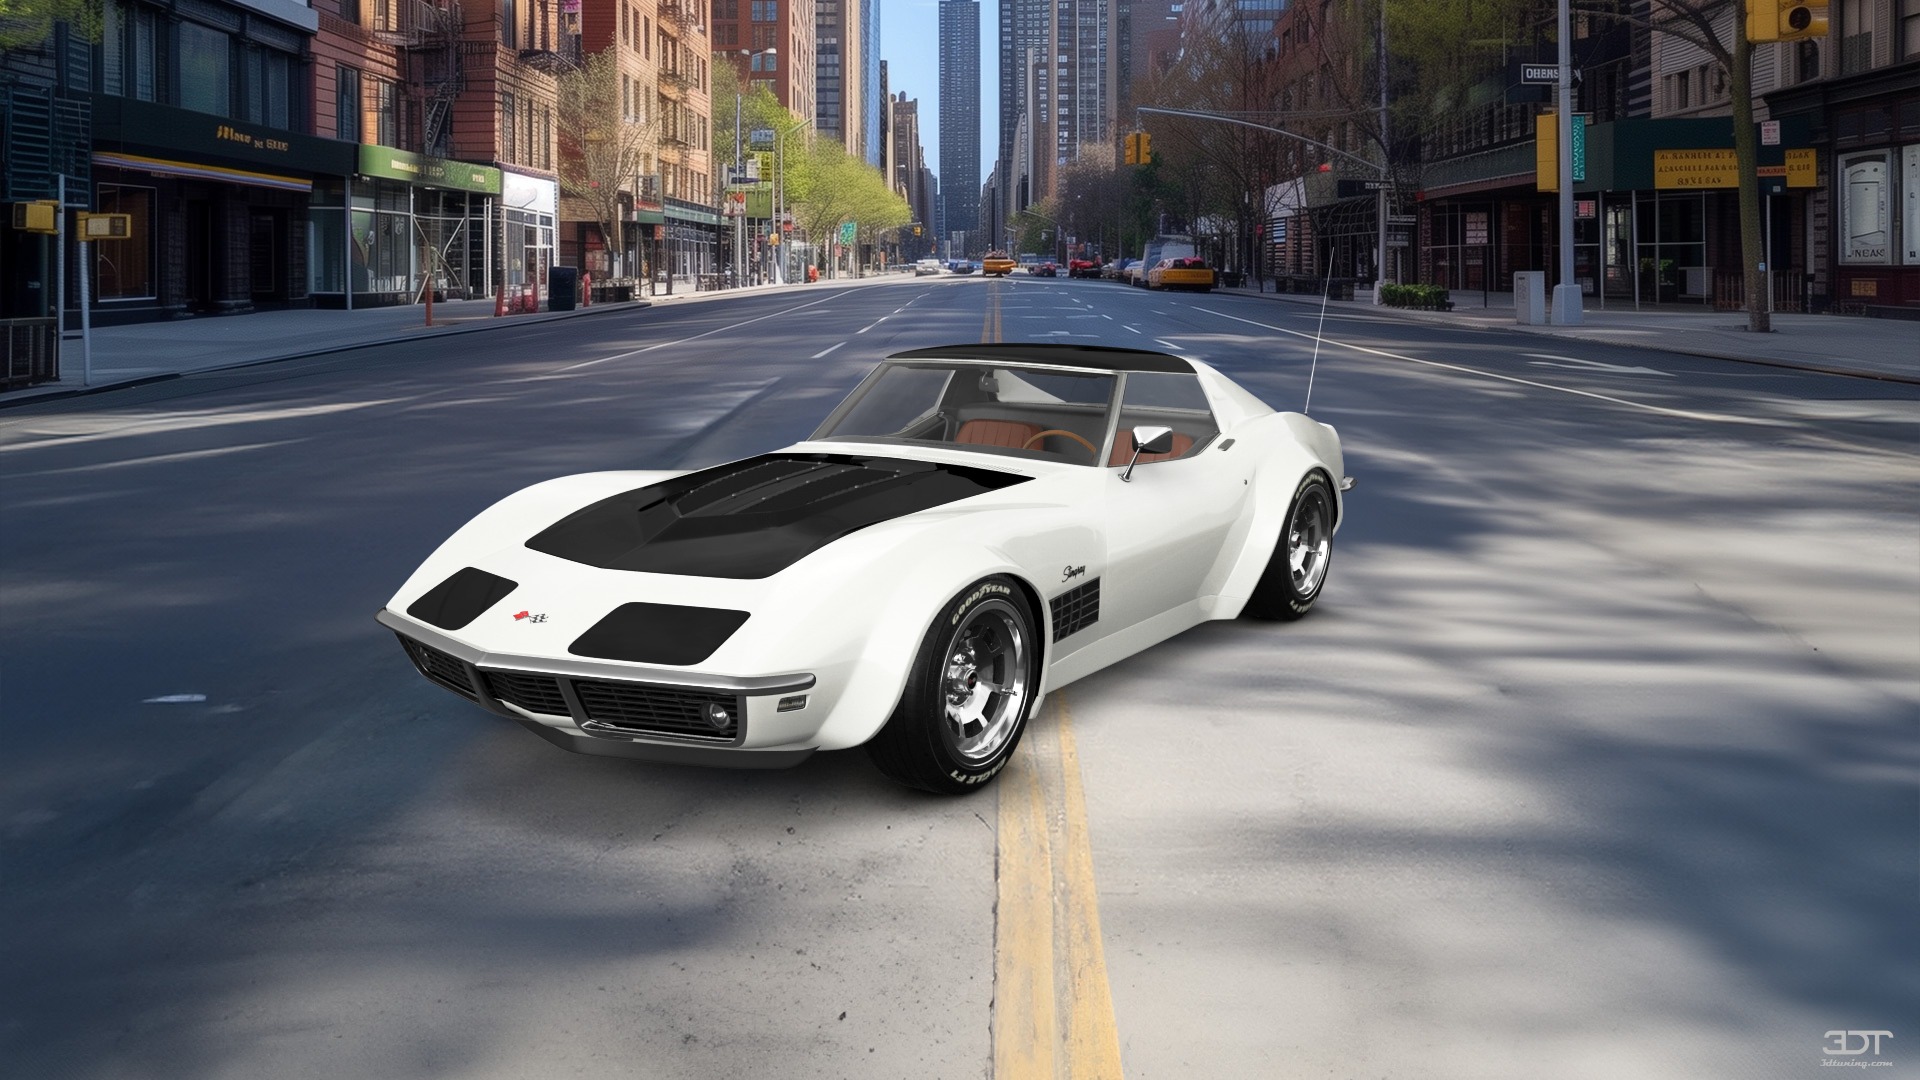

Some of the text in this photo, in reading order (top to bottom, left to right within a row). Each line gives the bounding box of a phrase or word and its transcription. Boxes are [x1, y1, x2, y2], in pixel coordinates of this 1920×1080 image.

[1062, 565, 1086, 583] Stingray
[952, 583, 1011, 625] GOODYEAR
[950, 769, 967, 783] F1
